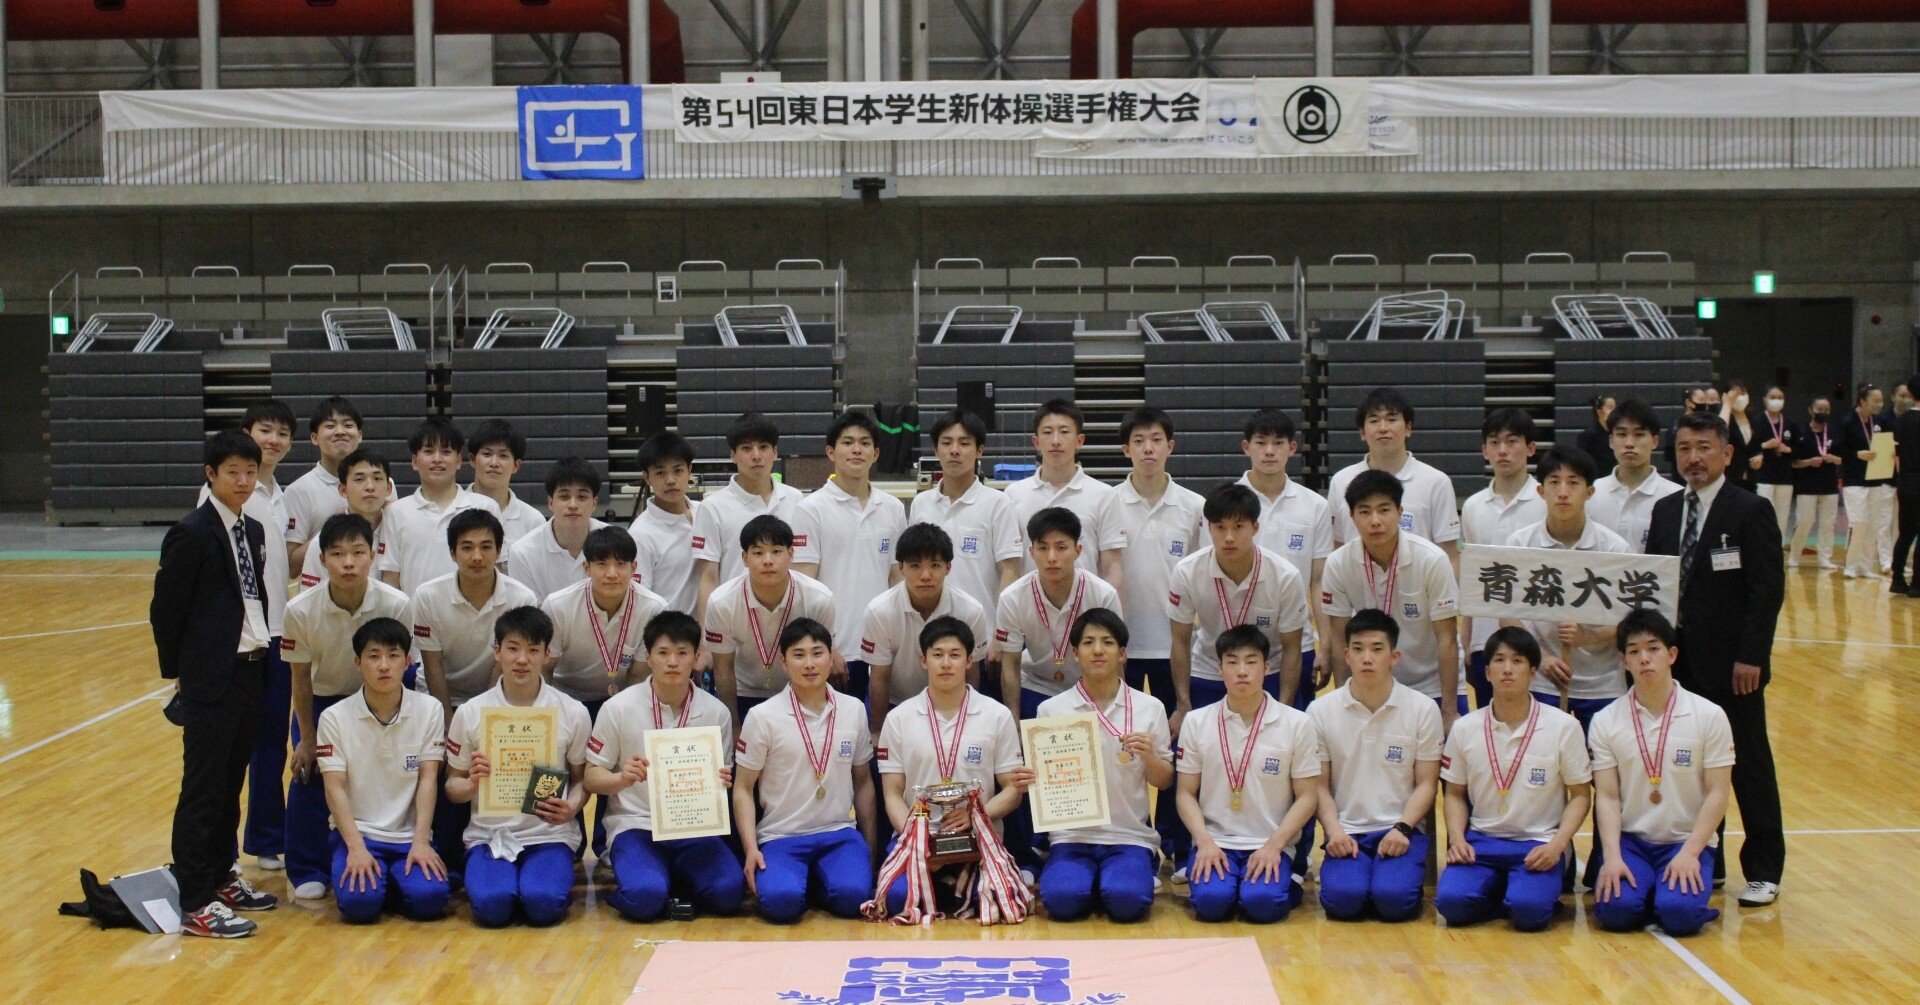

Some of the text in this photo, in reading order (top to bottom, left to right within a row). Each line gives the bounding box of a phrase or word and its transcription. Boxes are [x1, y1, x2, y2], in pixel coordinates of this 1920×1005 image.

[681, 92, 1200, 129] 第54回東日本学生新体操選手権大会
[1478, 561, 1661, 610] 青森大学
